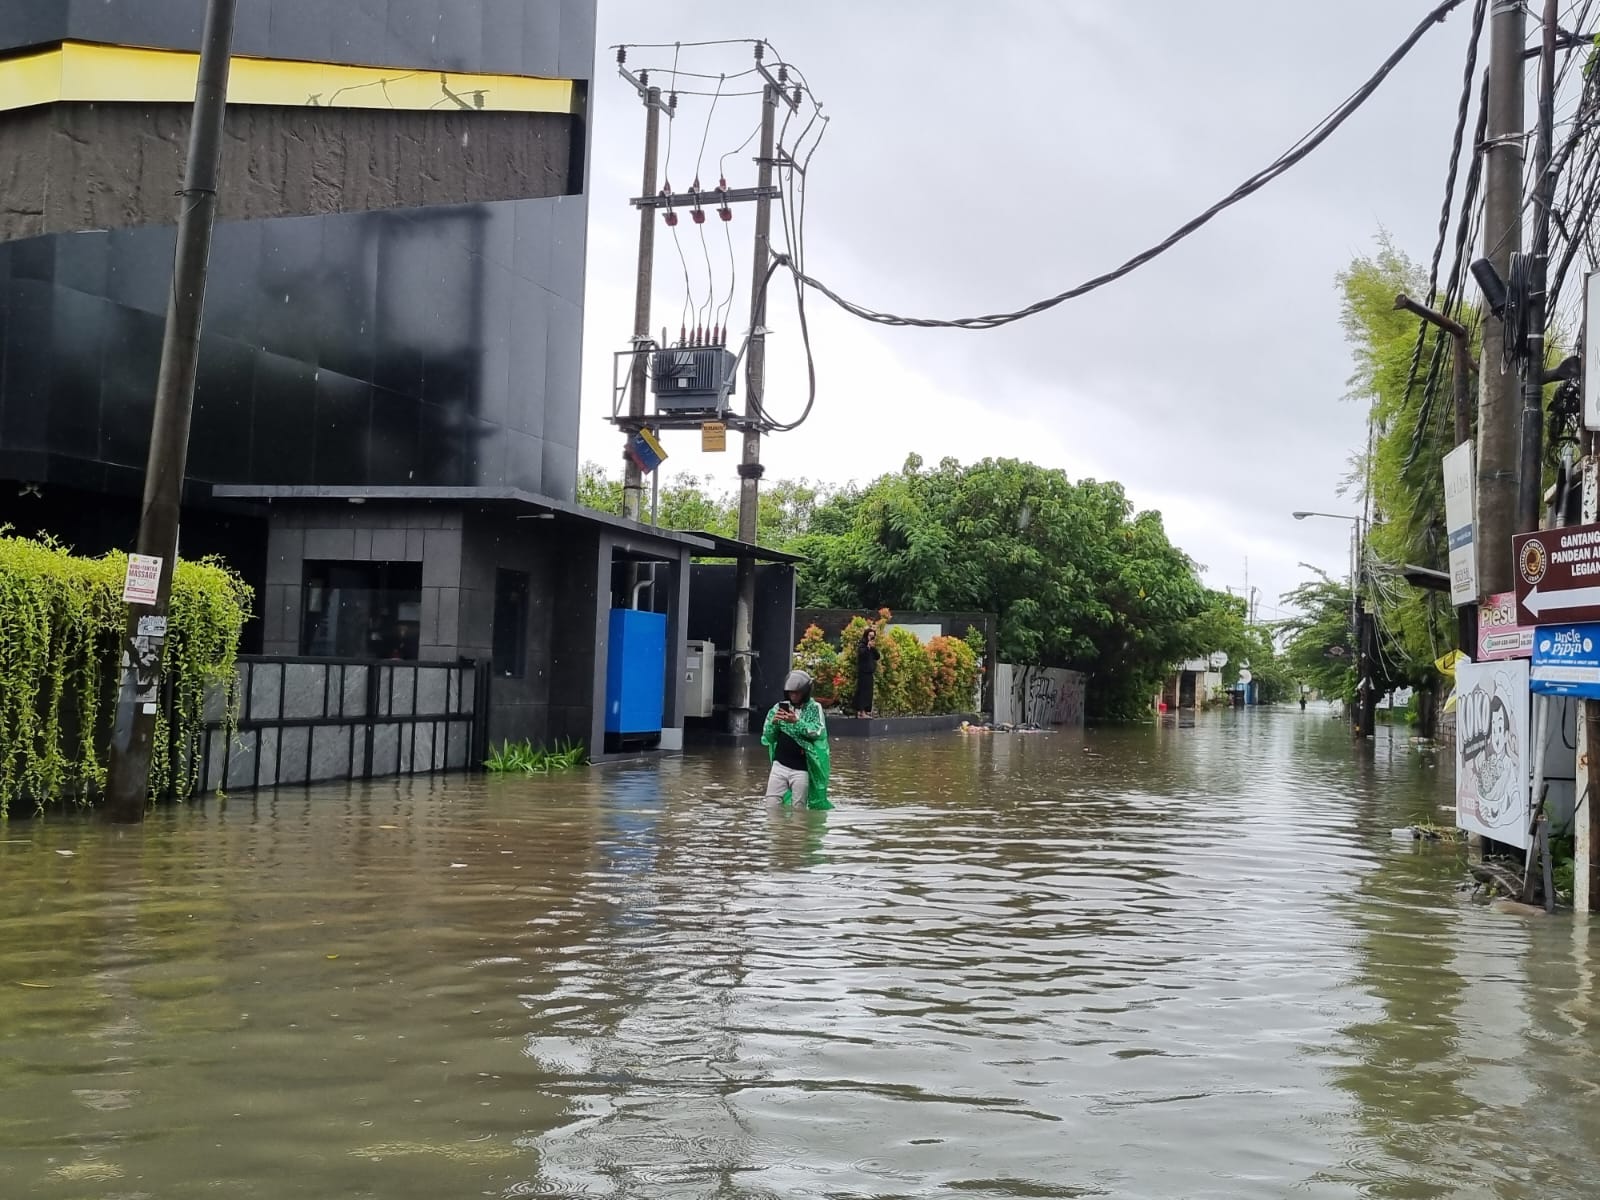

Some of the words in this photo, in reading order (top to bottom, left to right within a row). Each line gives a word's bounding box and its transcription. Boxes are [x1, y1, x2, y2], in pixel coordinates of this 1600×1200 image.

[1560, 531, 1600, 547] GANTANG
[1551, 547, 1591, 564] PANDEAN
[1592, 546, 1600, 559] A
[129, 570, 157, 579] MASSAGE
